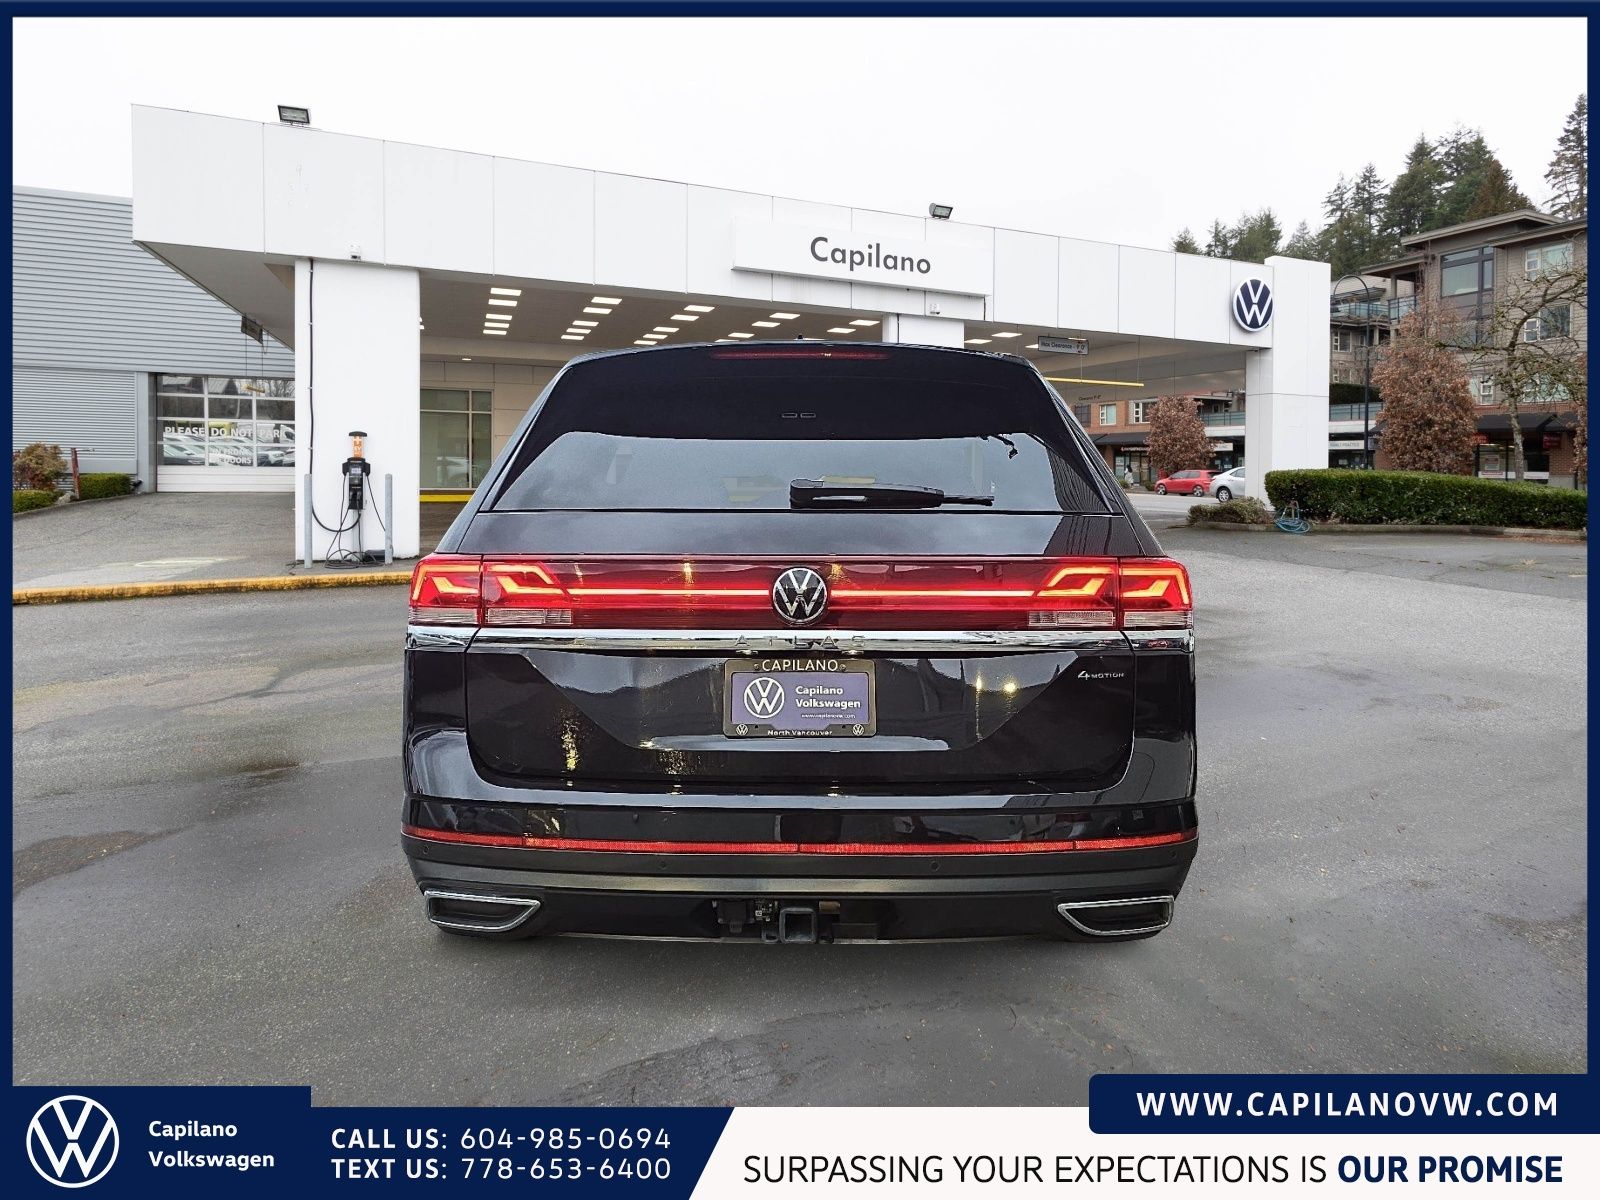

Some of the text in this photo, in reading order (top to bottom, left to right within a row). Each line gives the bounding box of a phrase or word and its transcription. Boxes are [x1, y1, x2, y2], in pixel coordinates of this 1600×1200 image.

[810, 236, 931, 275] Capilano
[164, 426, 206, 436] PLEASE
[211, 427, 226, 437] DO
[230, 428, 253, 438] NOT
[734, 634, 866, 650] ATLAS
[762, 659, 838, 672] CAPILANO
[795, 685, 844, 697] Capilano
[795, 698, 861, 710] Volkswagen
